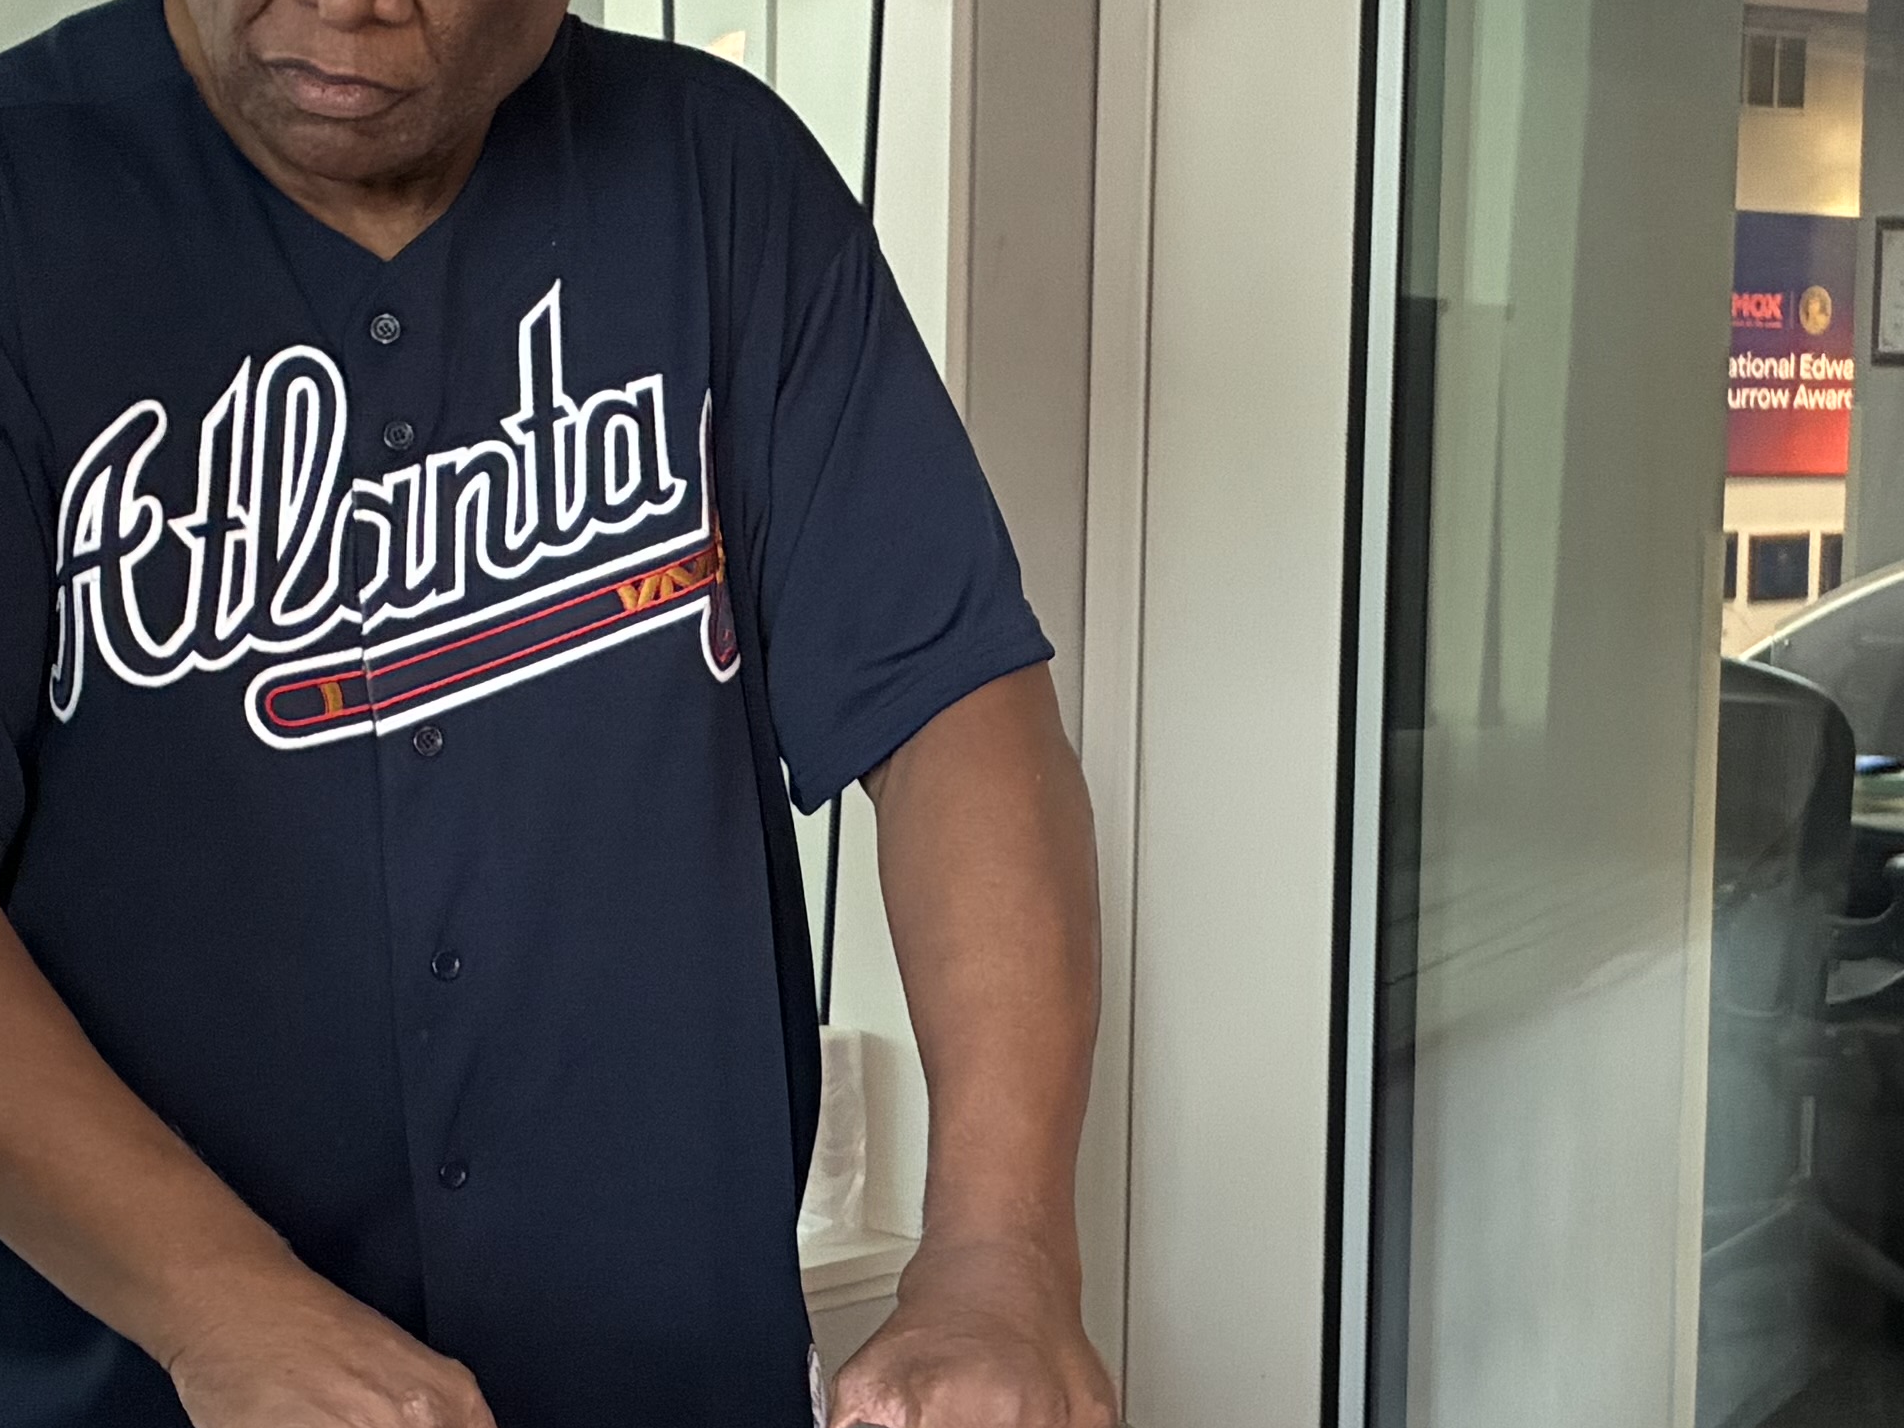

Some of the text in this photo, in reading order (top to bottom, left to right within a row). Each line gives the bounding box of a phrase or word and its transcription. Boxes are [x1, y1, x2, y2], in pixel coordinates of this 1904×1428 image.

[1728, 350, 1855, 381] ational Edwa
[1727, 387, 1790, 410] urrow
[47, 276, 689, 724] Atlanta
